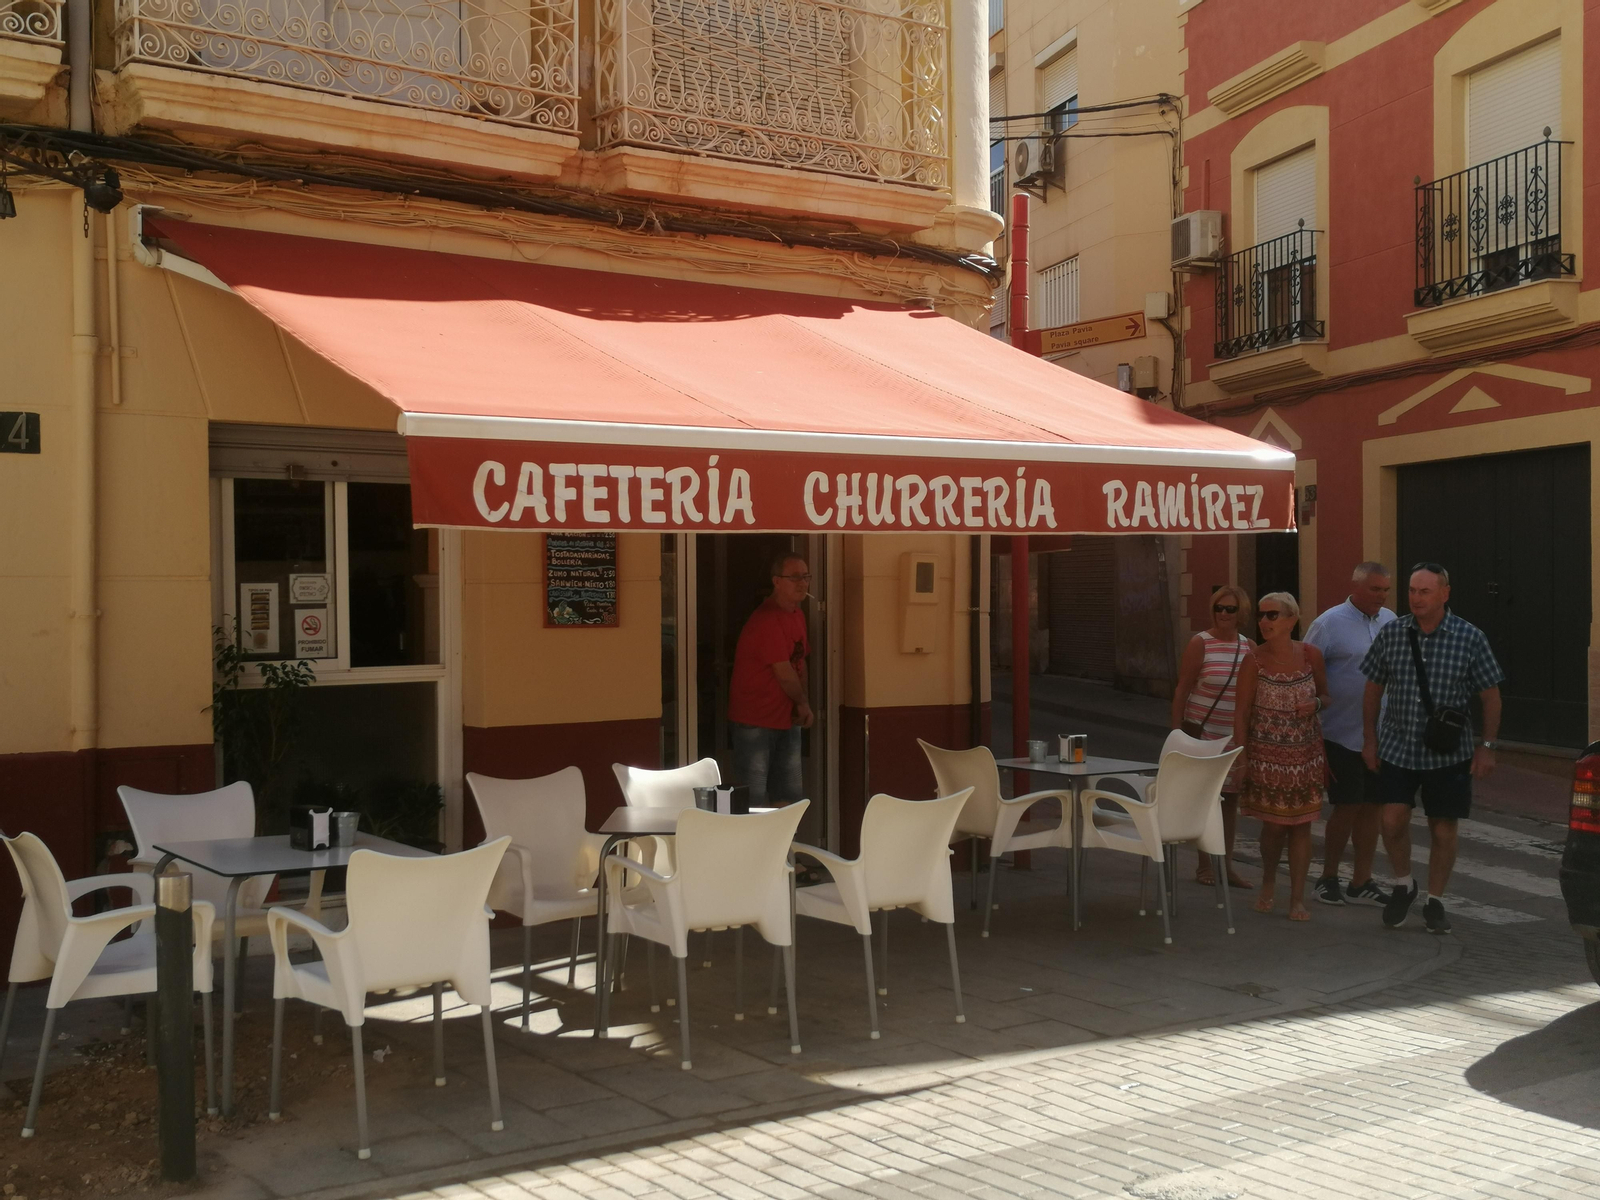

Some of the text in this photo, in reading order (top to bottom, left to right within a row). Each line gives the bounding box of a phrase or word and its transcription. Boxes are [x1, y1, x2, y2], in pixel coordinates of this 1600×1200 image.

[1072, 326, 1093, 334] Pavia
[1051, 336, 1099, 349] Pavia square
[8, 412, 29, 450] 4
[473, 455, 1271, 530] CAFETERÍA CHURRERÍA RAMÍREZ
[570, 570, 600, 578] NATURAL
